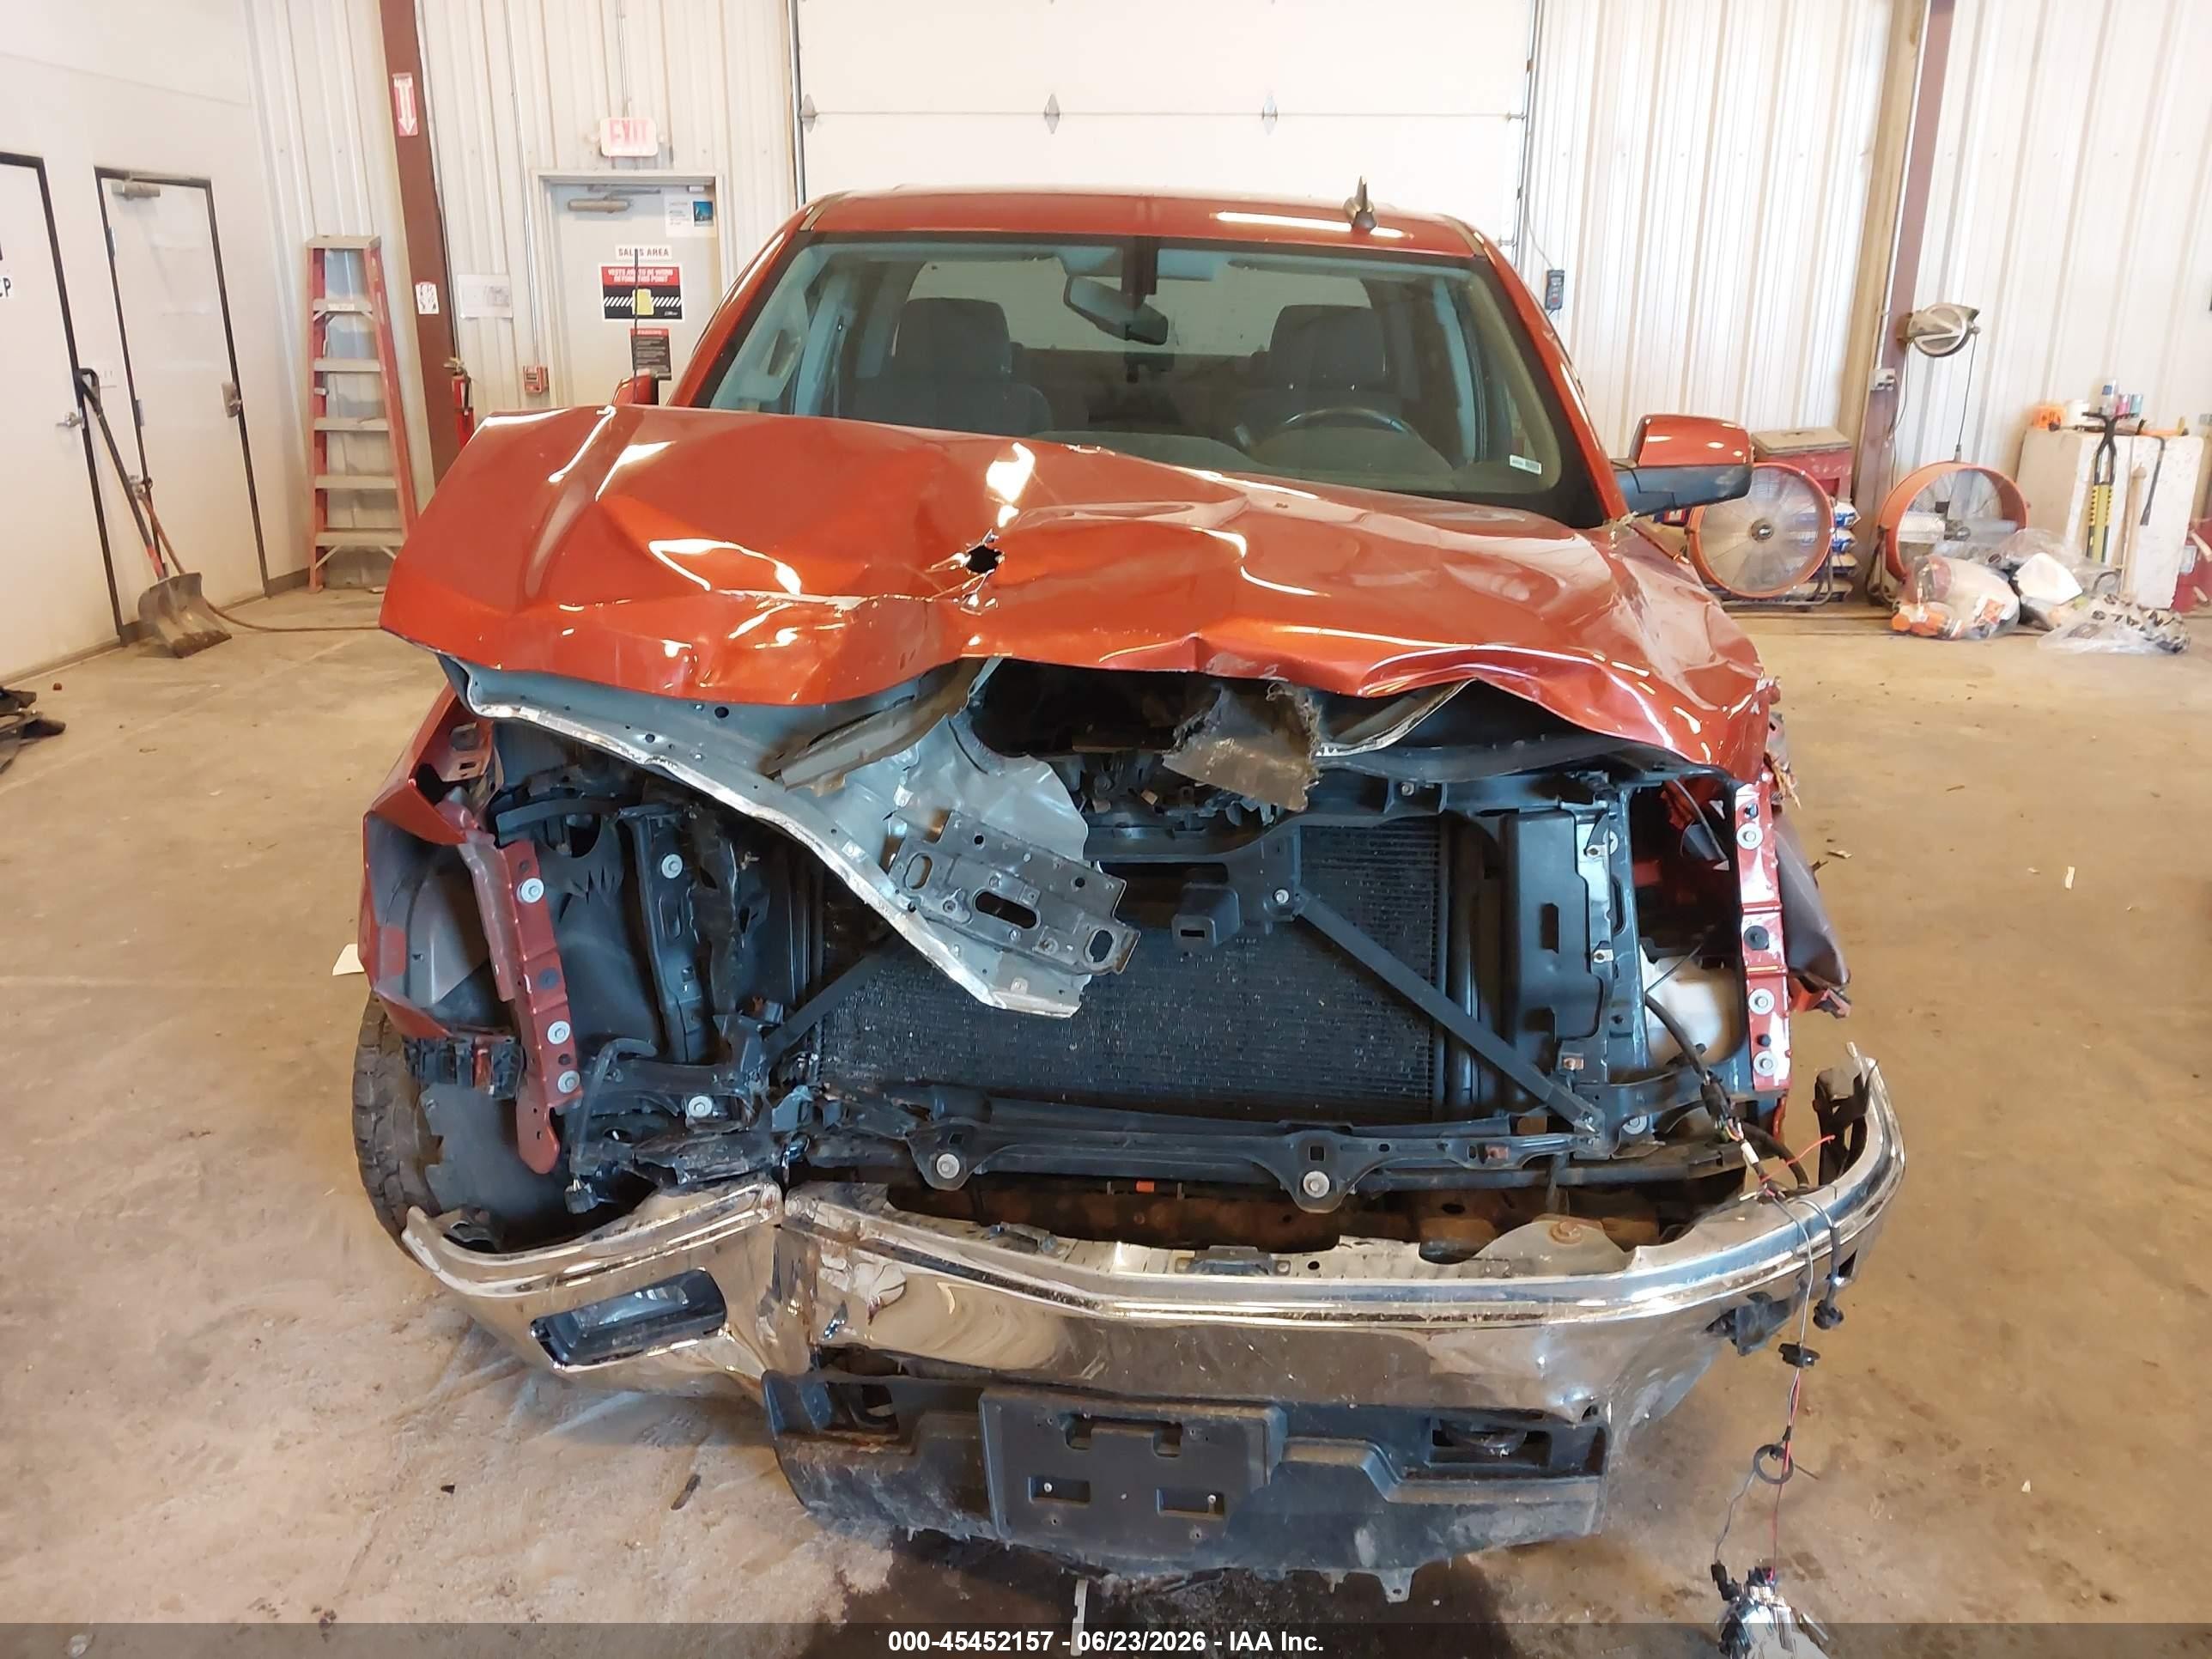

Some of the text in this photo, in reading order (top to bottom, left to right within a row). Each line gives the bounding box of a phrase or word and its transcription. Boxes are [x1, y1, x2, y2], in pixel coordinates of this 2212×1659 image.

[609, 118, 647, 144] EXIT
[618, 247, 669, 257] SALS AREA
